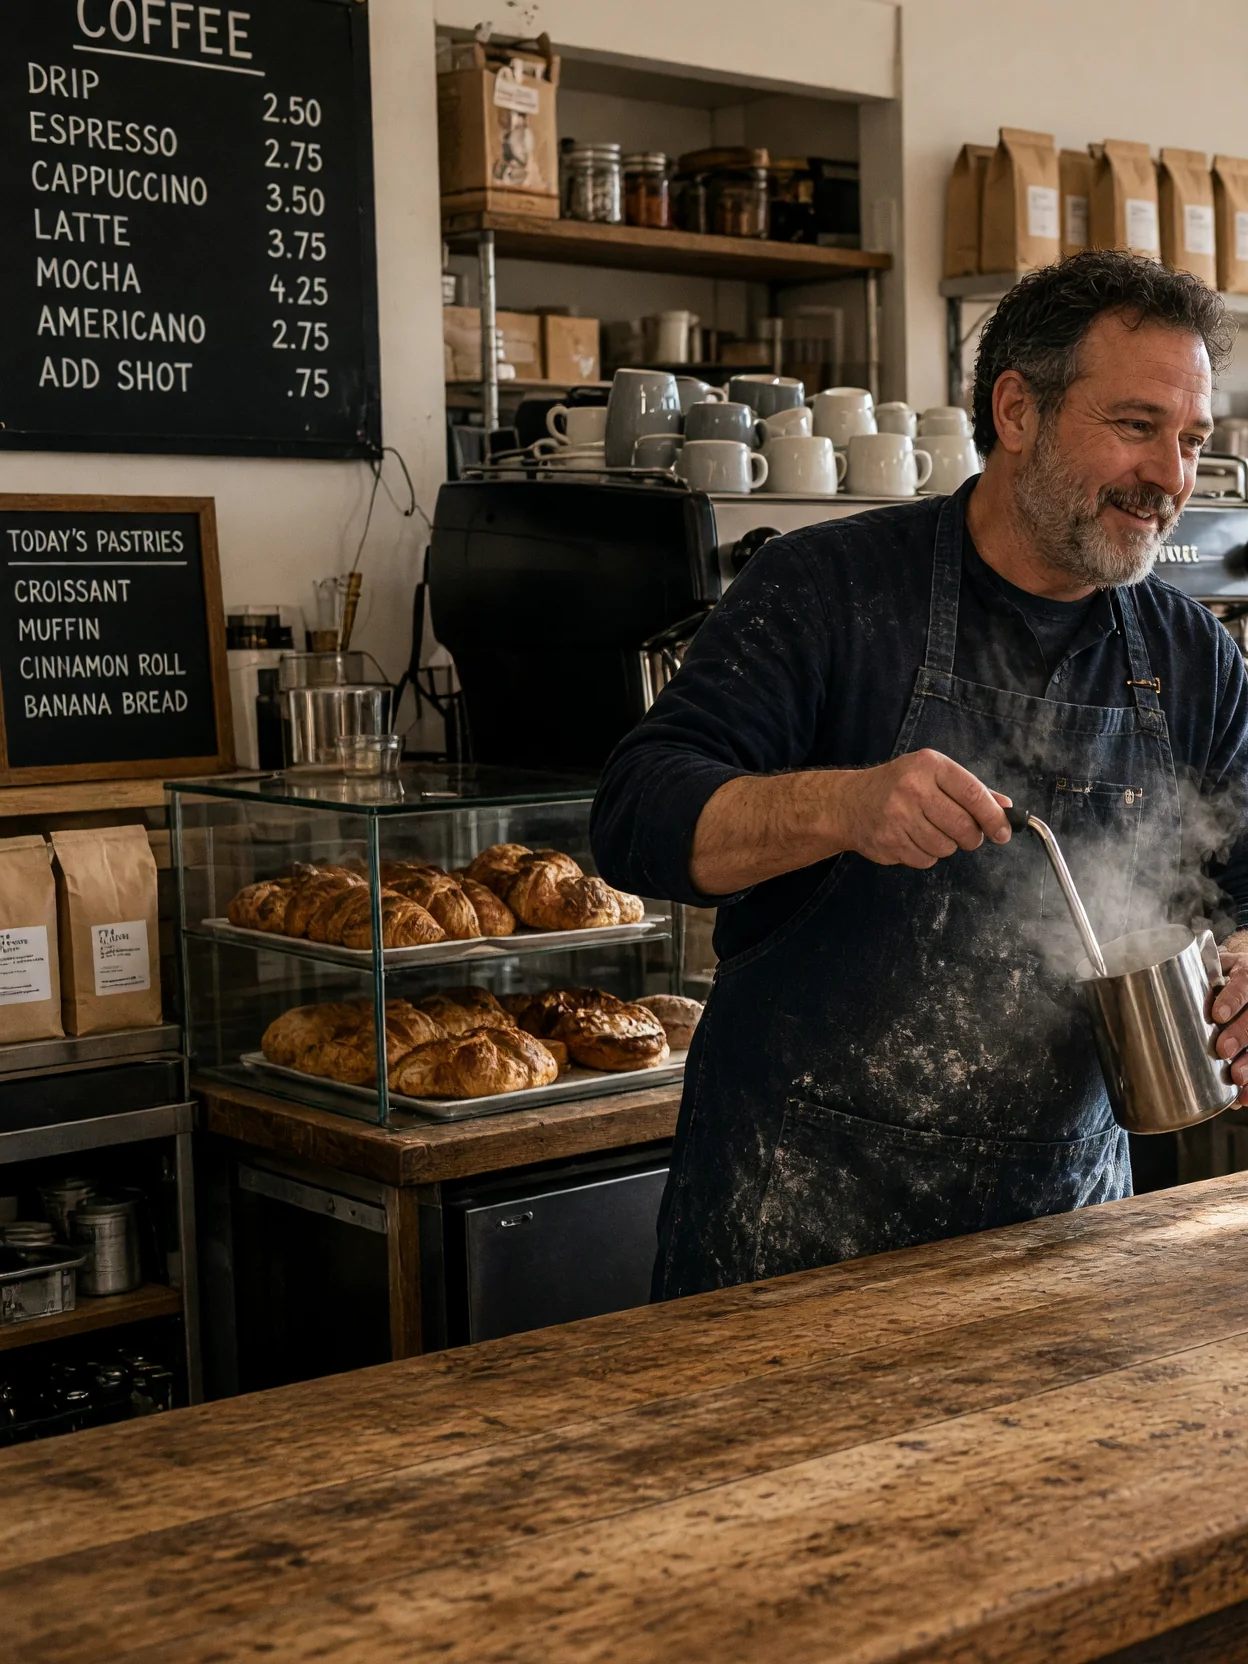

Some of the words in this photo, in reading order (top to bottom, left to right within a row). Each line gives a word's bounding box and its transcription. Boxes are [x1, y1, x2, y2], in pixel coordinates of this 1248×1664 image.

[77, 0, 253, 59] COFFEE
[28, 63, 99, 99] DRIP
[263, 93, 322, 127] 2.50
[30, 112, 177, 157] ESPRESSO
[264, 139, 323, 172] 2.75
[32, 160, 208, 206] CAPPUCCINO
[266, 184, 325, 216] 3.50
[34, 208, 130, 246] LATTE
[267, 229, 326, 261] 3.75
[36, 257, 141, 294] MOCHA
[269, 274, 328, 305] 4.25
[37, 305, 206, 344] AMERICANO
[272, 320, 329, 351] 2.75
[39, 356, 100, 389] ADD
[117, 360, 193, 392] SHOT
[287, 369, 329, 398] .75
[7, 528, 88, 552] TODAY'S
[97, 530, 184, 552] PASTRIES
[14, 579, 131, 602] CROISSANT
[19, 617, 100, 641] MUFFIN
[20, 654, 129, 679] CINNAMON
[139, 653, 186, 676] ROLL
[25, 693, 112, 718] BANANA
[122, 690, 188, 715] BREAD
